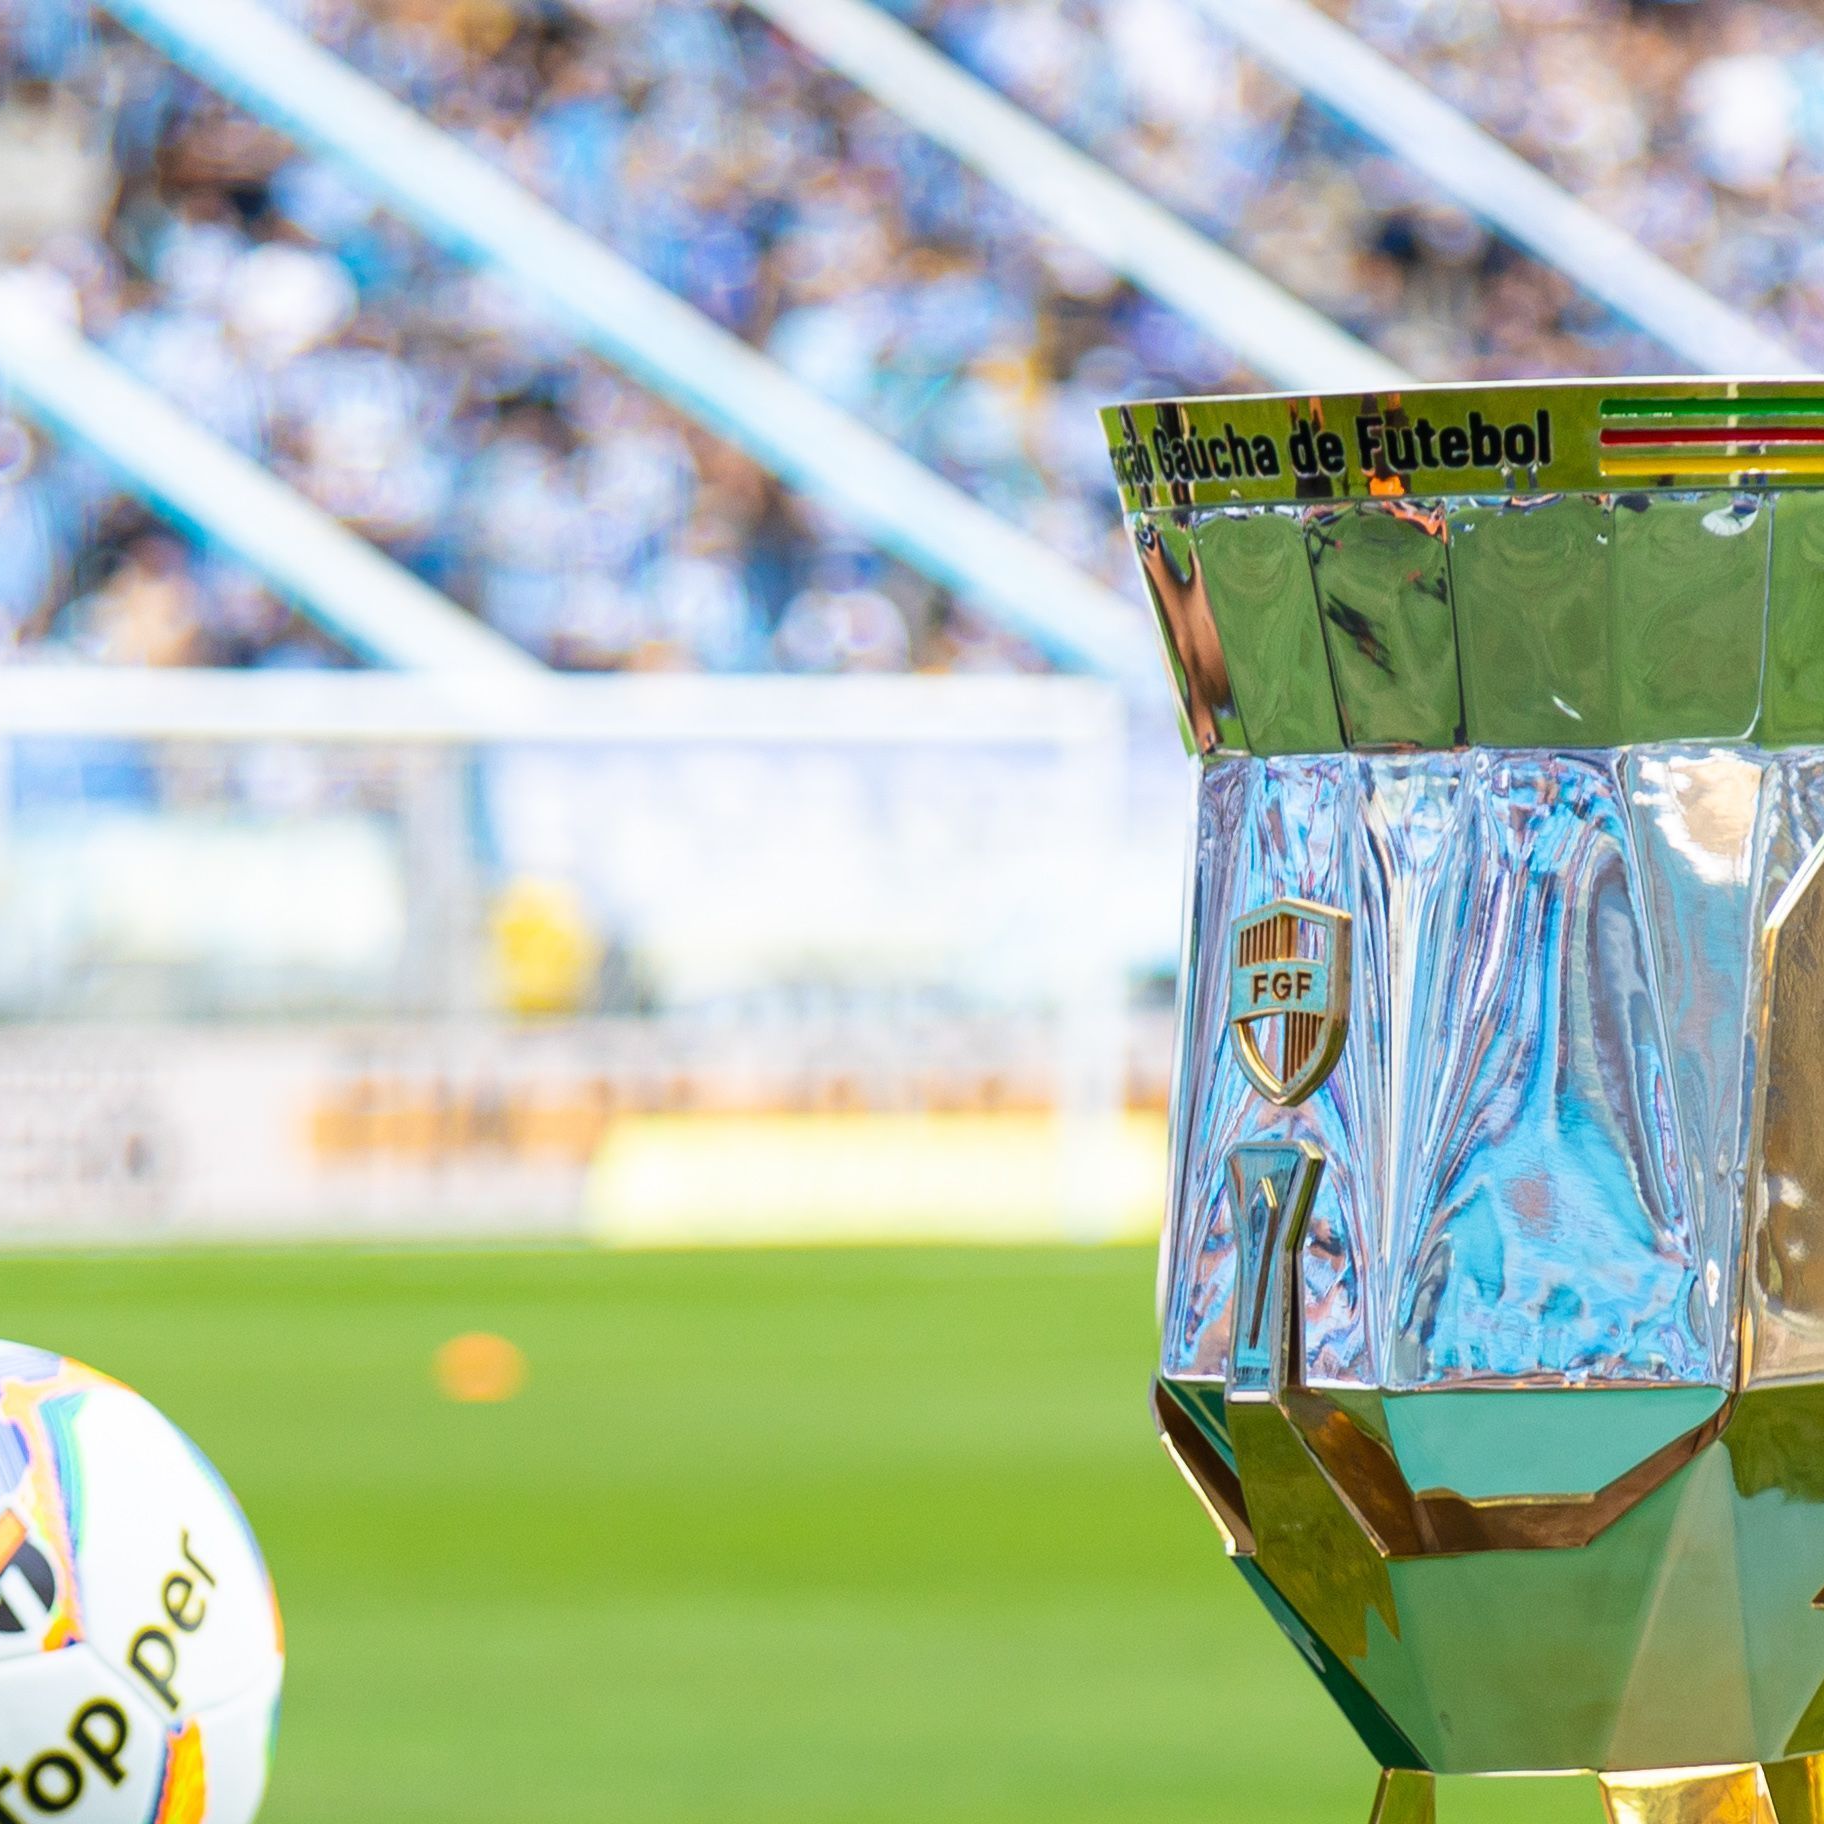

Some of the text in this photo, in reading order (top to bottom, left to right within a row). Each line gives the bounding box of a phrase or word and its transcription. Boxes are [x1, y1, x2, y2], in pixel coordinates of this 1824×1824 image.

[1152, 423, 1281, 481] Gaúcha
[1288, 418, 1346, 477] de
[1354, 408, 1552, 473] Futebol
[1252, 970, 1313, 1005] FGF
